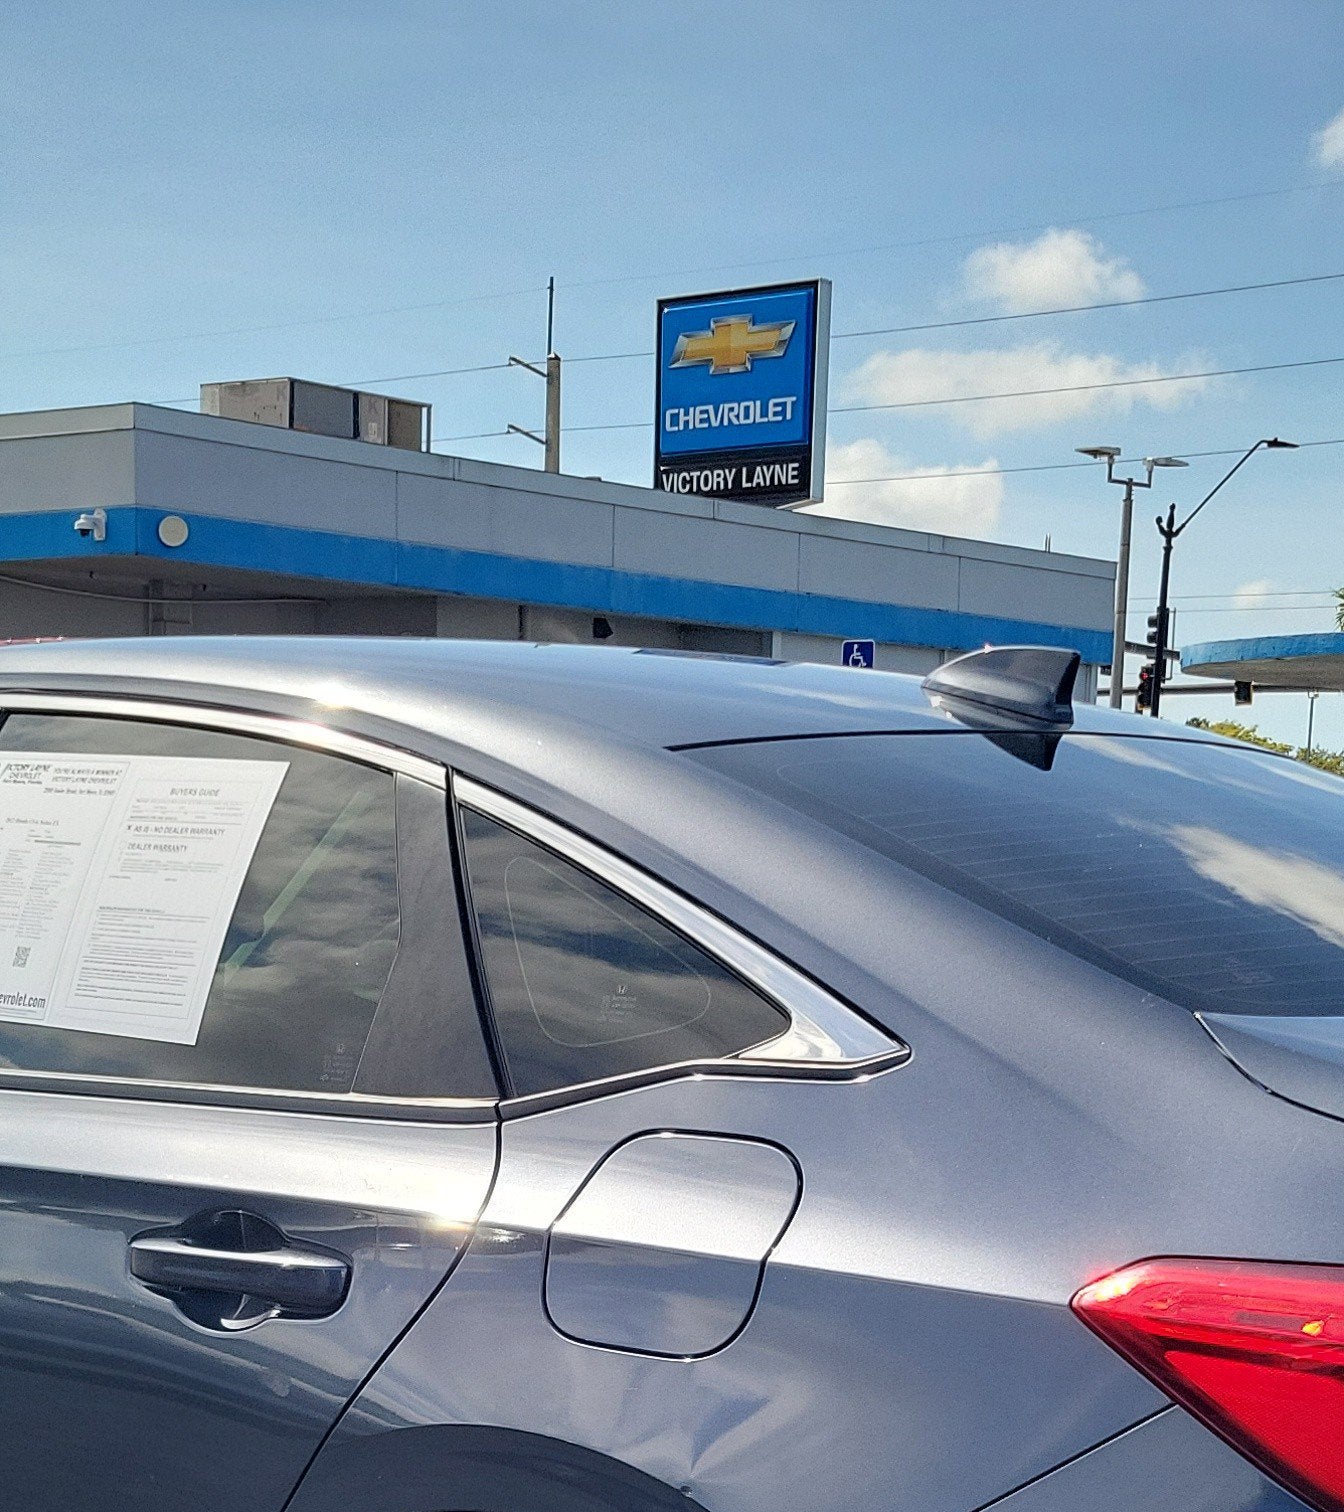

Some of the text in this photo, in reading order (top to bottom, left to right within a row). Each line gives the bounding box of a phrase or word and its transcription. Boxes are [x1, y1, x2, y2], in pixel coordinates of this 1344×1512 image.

[665, 396, 797, 432] CHEVROLET
[662, 462, 799, 494] VICTORY LAYNE
